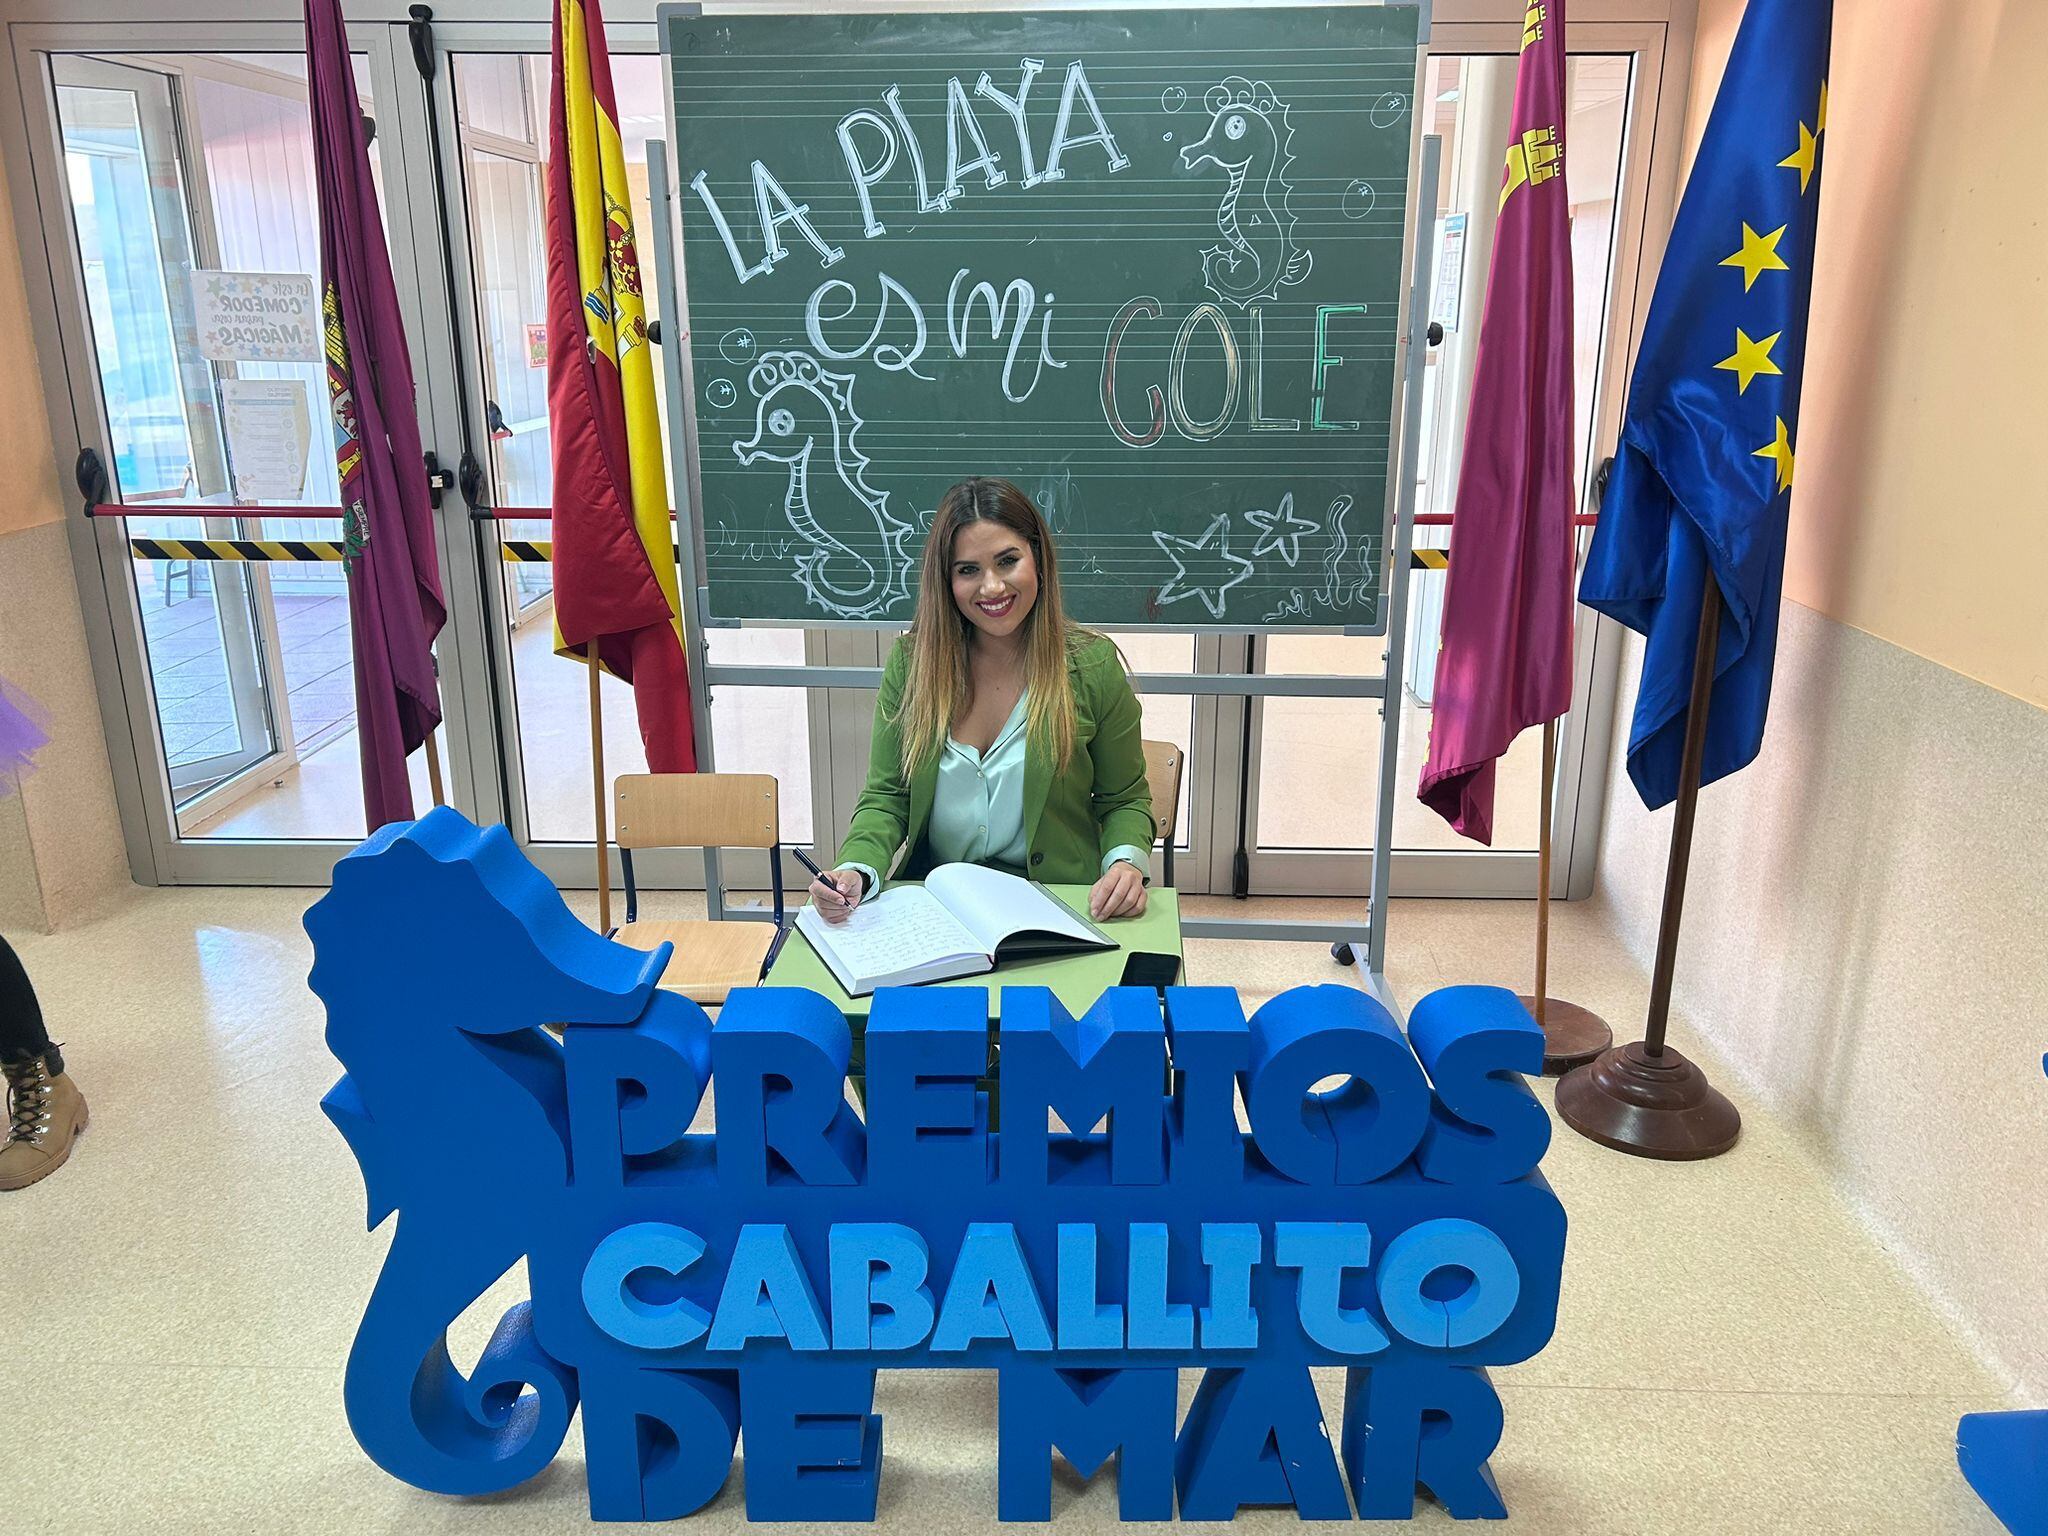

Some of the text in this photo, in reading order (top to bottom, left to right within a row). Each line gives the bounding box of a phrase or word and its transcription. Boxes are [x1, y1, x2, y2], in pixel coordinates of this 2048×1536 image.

[690, 57, 1130, 283] LA PLAYA
[805, 268, 1368, 448] es mi COLE
[562, 989, 1552, 1188] PREMIOS
[580, 1216, 1522, 1356] CABALLITO
[585, 1366, 1510, 1523] DE MAR
